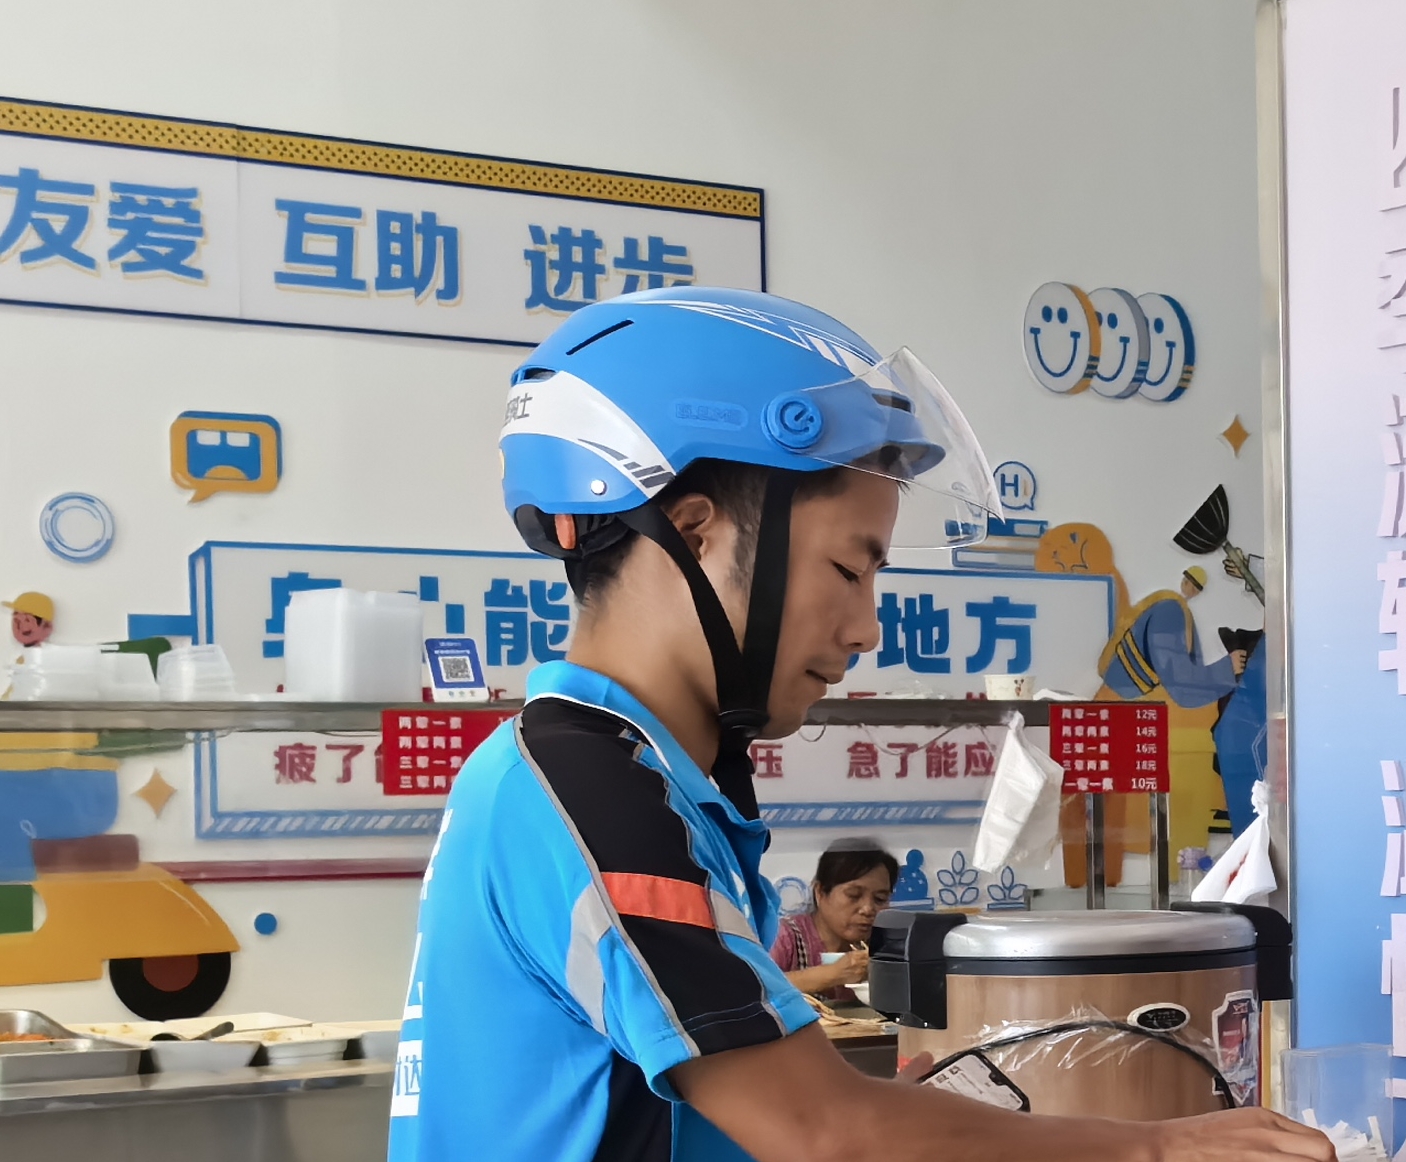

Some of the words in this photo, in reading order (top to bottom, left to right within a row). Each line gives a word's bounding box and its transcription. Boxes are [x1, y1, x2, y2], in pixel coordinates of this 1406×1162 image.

[0, 168, 204, 281] 友爱
[274, 198, 460, 304] 互助
[522, 224, 694, 313] 进步
[274, 743, 384, 785] 疲了
[1131, 777, 1157, 790] 10元
